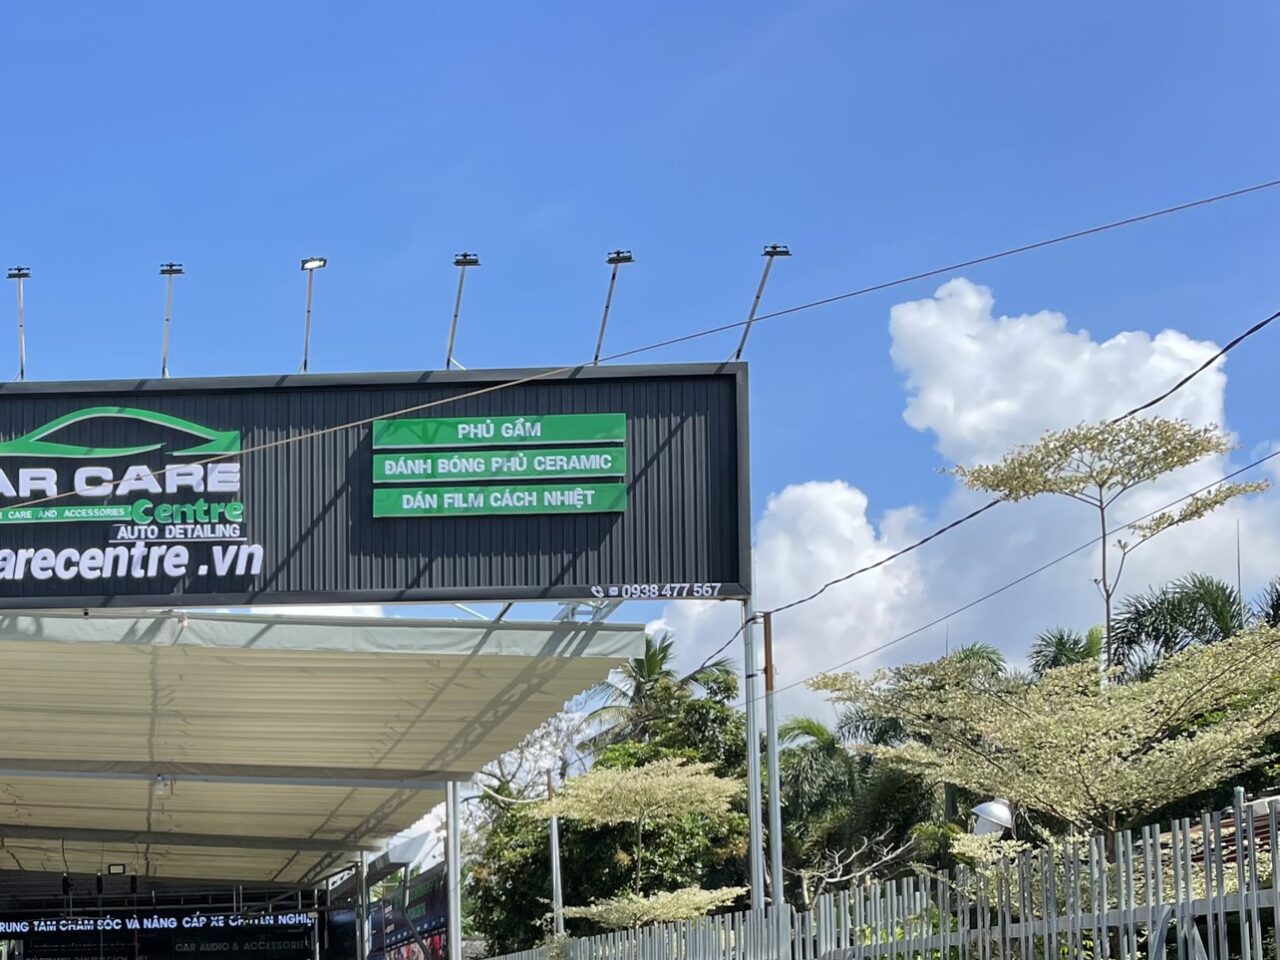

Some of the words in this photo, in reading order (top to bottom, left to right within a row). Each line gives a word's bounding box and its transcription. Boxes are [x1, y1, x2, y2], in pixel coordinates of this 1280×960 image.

[457, 419, 495, 439] PHỦ
[500, 417, 542, 437] GẦM
[384, 456, 433, 475] ĐÁNH
[437, 455, 486, 474] BÓNG
[491, 453, 528, 472] PHỦ
[533, 454, 613, 471] CERAMIC
[73, 463, 241, 497] CARE
[402, 491, 438, 509] DÁN
[443, 493, 484, 508] FILM
[489, 488, 537, 507] CÁCH
[543, 487, 596, 508] NHIỆT
[8, 510, 33, 520] CARE
[38, 509, 58, 519] AND
[63, 507, 125, 518] ACCESSORIES
[130, 498, 244, 525] Centre
[118, 525, 159, 540] AUTO
[165, 523, 241, 539] DETAILING
[621, 584, 659, 598] 0938
[661, 583, 691, 597] 477
[693, 583, 722, 597] 567
[33, 917, 57, 931] TÂM
[96, 914, 123, 930] SÓC
[125, 914, 141, 929] VÀ
[143, 915, 178, 929] NÂNG
[182, 911, 208, 928] CẤP
[210, 915, 225, 927] XE
